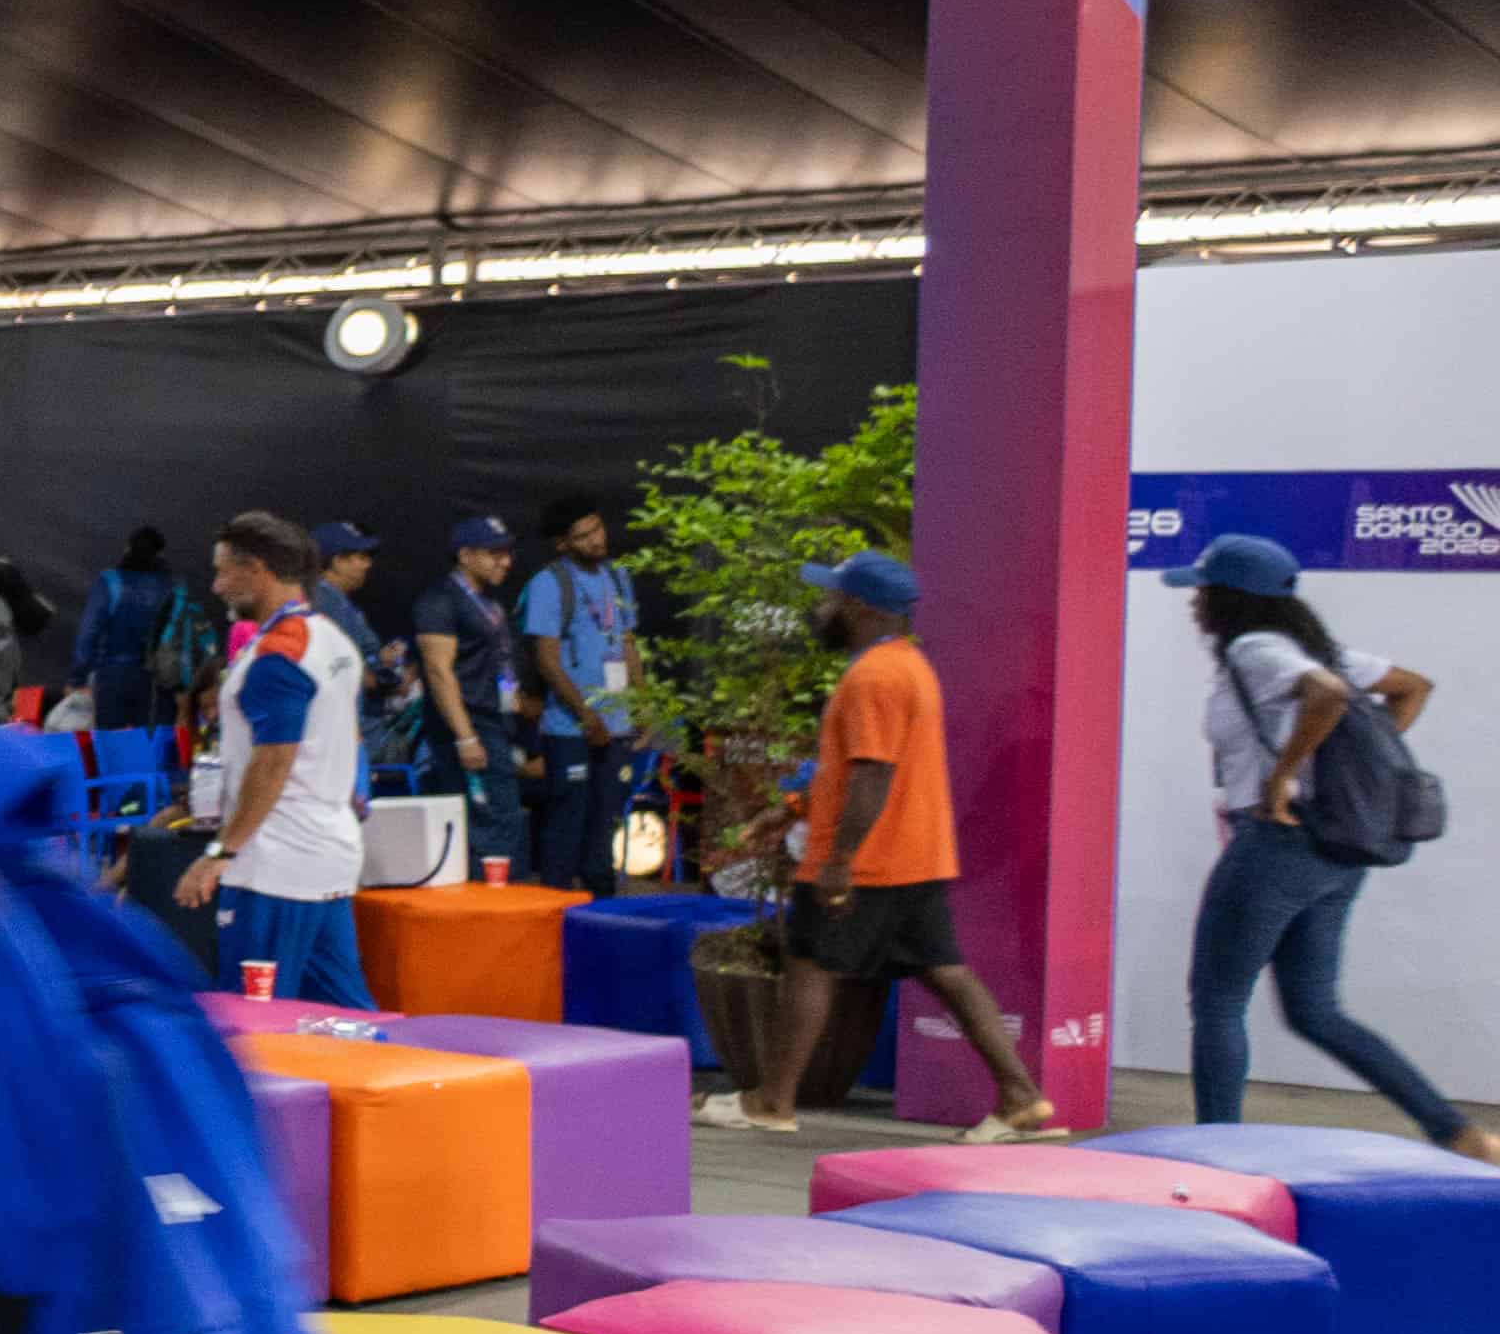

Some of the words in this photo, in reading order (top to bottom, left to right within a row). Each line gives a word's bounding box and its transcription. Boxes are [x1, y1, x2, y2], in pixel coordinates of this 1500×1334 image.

[1356, 505, 1453, 523] SANTO
[1356, 523, 1482, 539] DOMINGO
[1419, 538, 1500, 555] 2026
